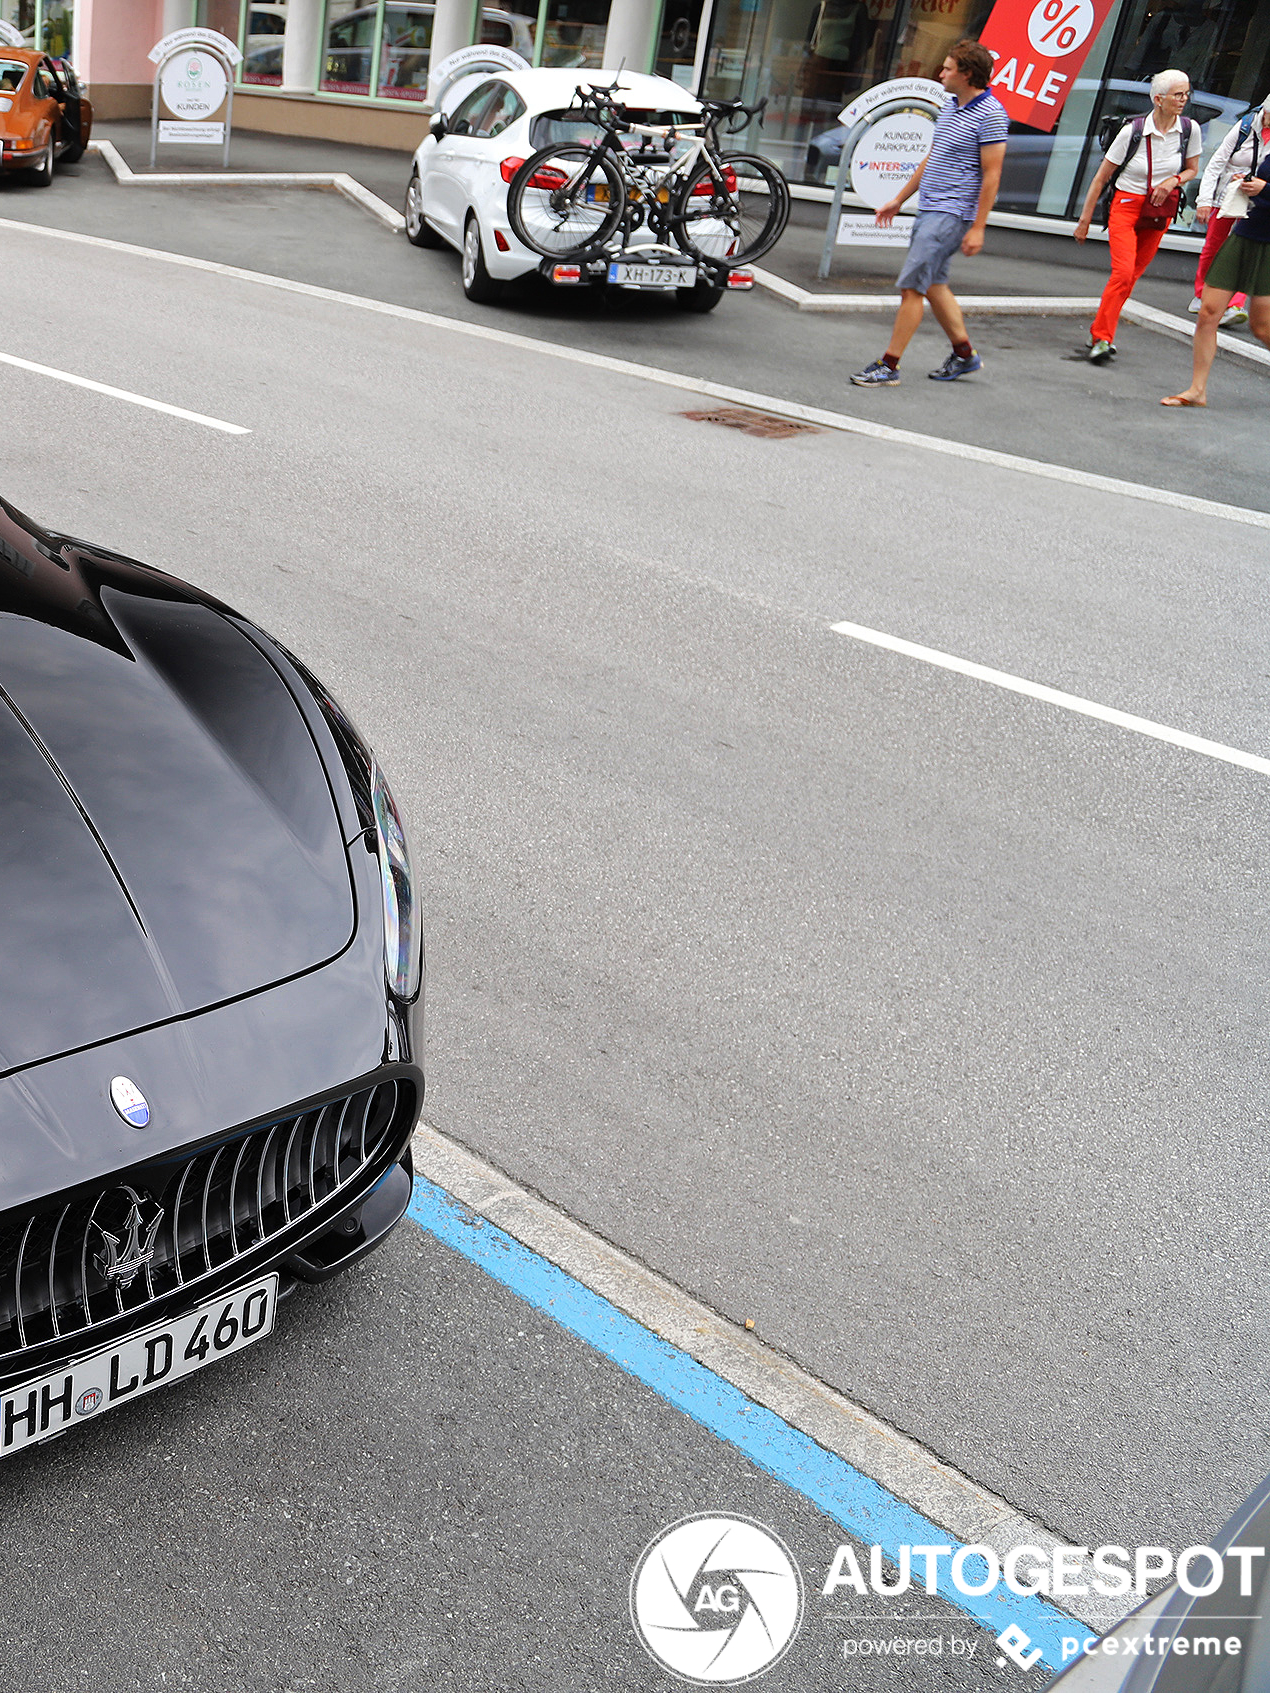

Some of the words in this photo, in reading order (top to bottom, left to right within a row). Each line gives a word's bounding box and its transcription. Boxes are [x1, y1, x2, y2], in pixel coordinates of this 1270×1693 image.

[177, 103, 211, 111] KUNDEN
[883, 132, 923, 141] KUNDEN
[874, 143, 927, 153] PARKPLATZ
[624, 267, 688, 284] XH-173-K
[4, 1375, 74, 1447] HH
[109, 1333, 173, 1401] LD
[184, 1288, 268, 1361] 460
